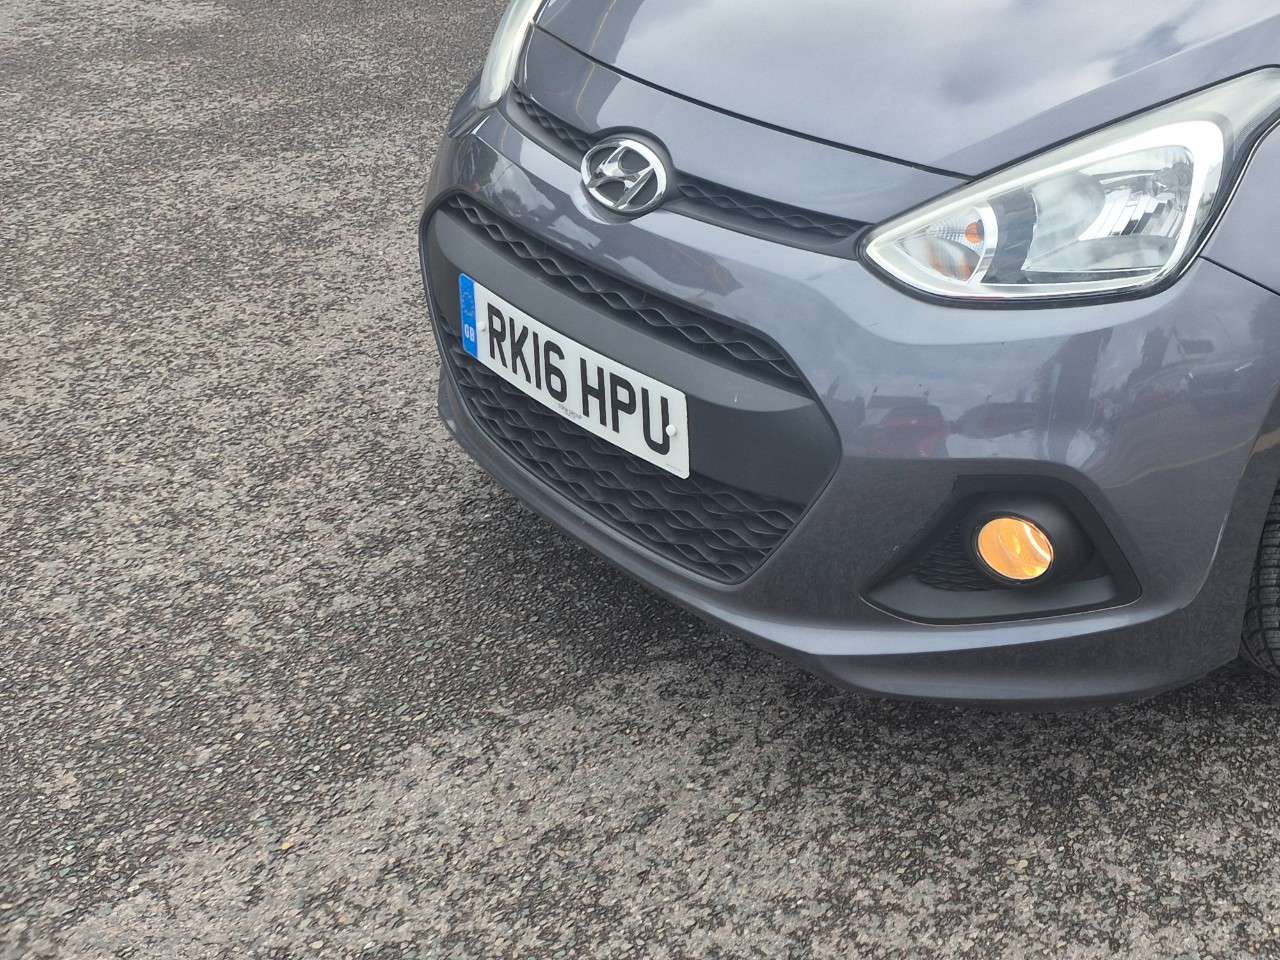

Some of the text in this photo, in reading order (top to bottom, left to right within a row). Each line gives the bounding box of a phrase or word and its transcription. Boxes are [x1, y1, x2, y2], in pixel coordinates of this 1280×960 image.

[464, 323, 475, 343] GB
[487, 302, 671, 456] RK16 HPU
